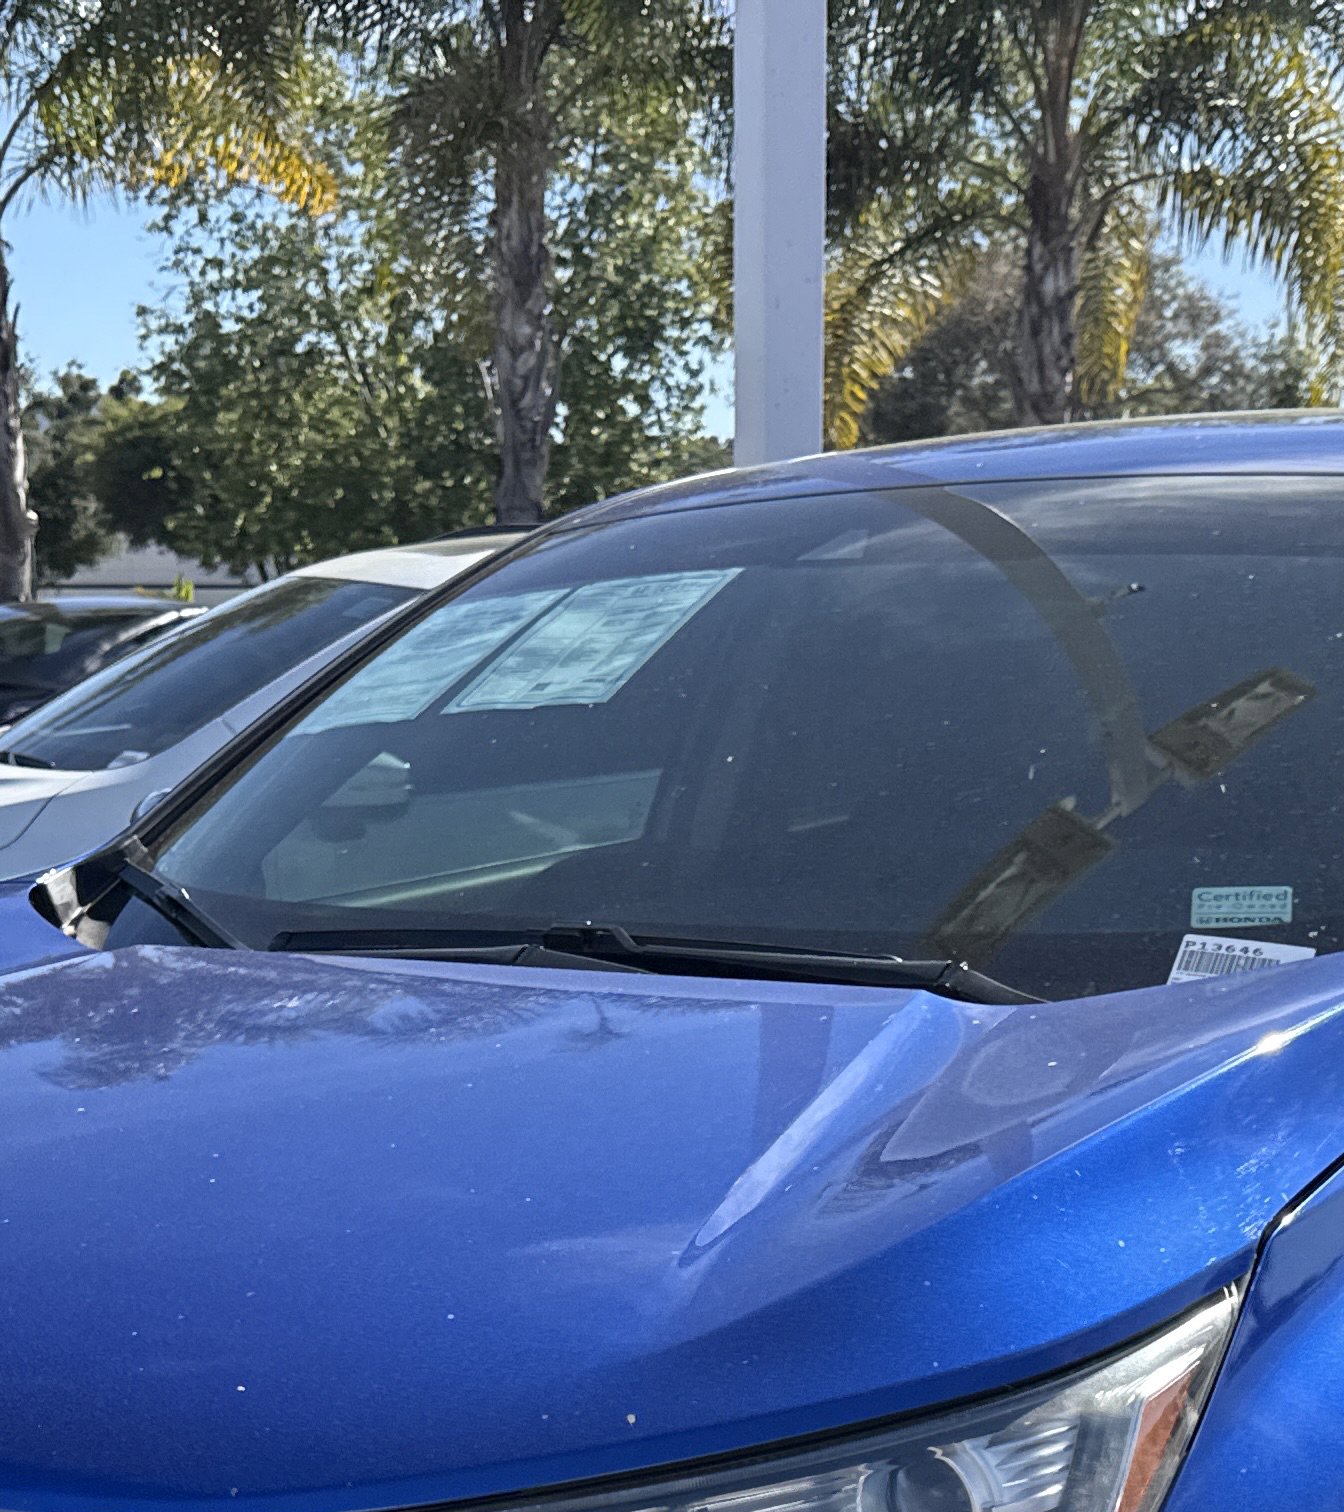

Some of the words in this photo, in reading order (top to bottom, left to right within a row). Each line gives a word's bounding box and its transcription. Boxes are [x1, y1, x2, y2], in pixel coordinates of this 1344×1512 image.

[1197, 889, 1288, 902] Certified
[1214, 916, 1285, 924] HONDA
[1183, 940, 1265, 957] P13646
